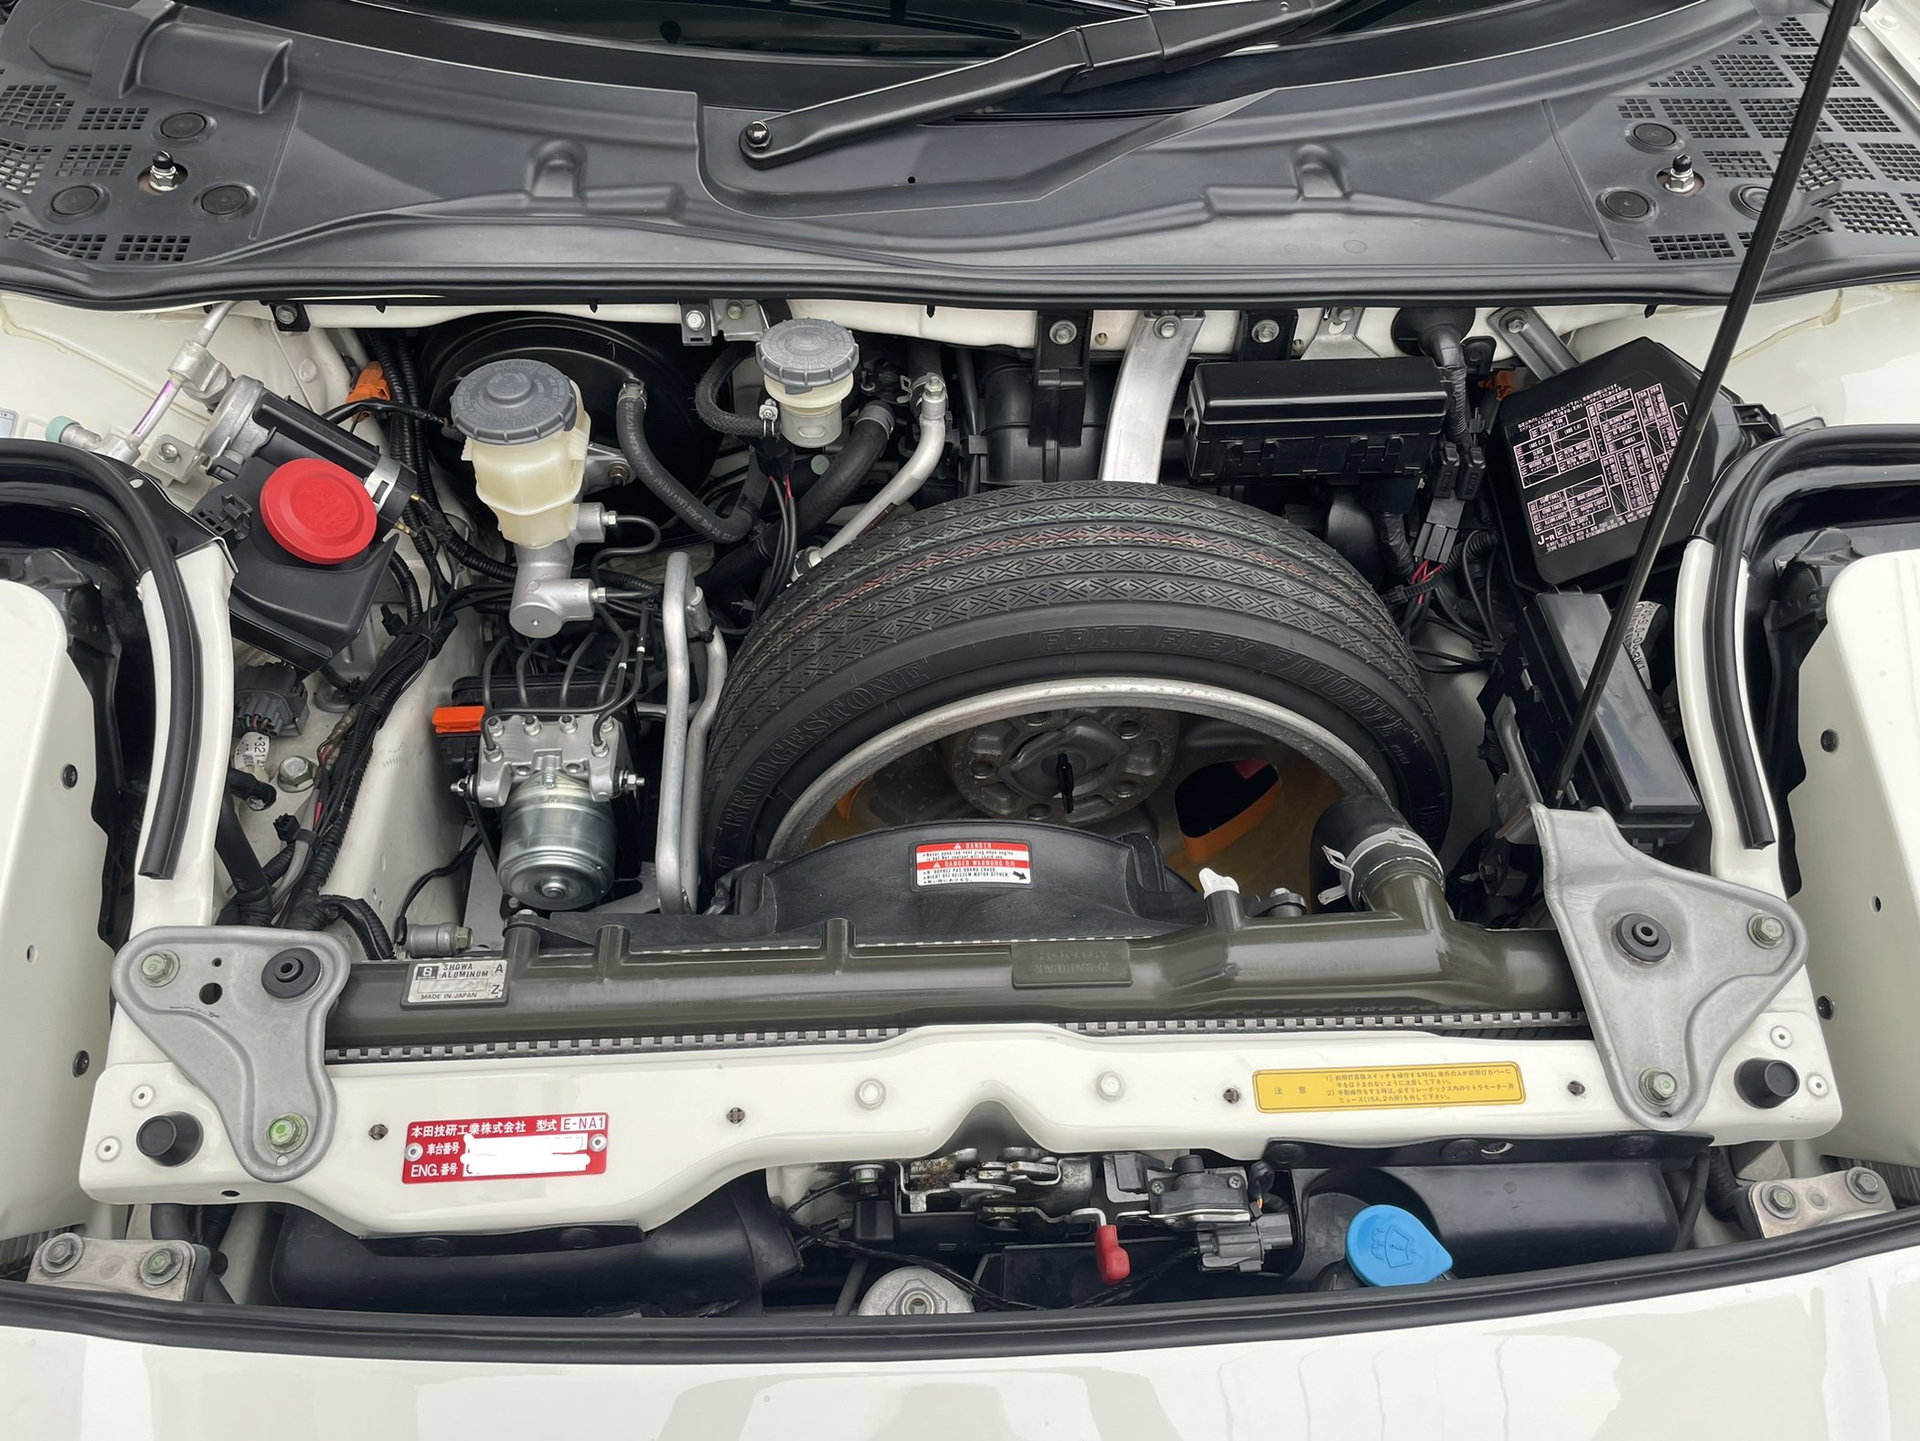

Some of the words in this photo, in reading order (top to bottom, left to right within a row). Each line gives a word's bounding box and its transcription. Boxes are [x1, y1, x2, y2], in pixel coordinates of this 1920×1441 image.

[724, 664, 929, 827] BRIDGESTONE
[443, 963, 473, 971] SHOWA
[494, 963, 503, 973] A
[441, 970, 488, 978] ALUMINUM
[411, 1120, 527, 1138] 本田技研工業株式会社
[536, 1119, 558, 1132] 型式
[563, 1116, 605, 1130] E-NA1
[427, 1141, 460, 1156] 車台番号
